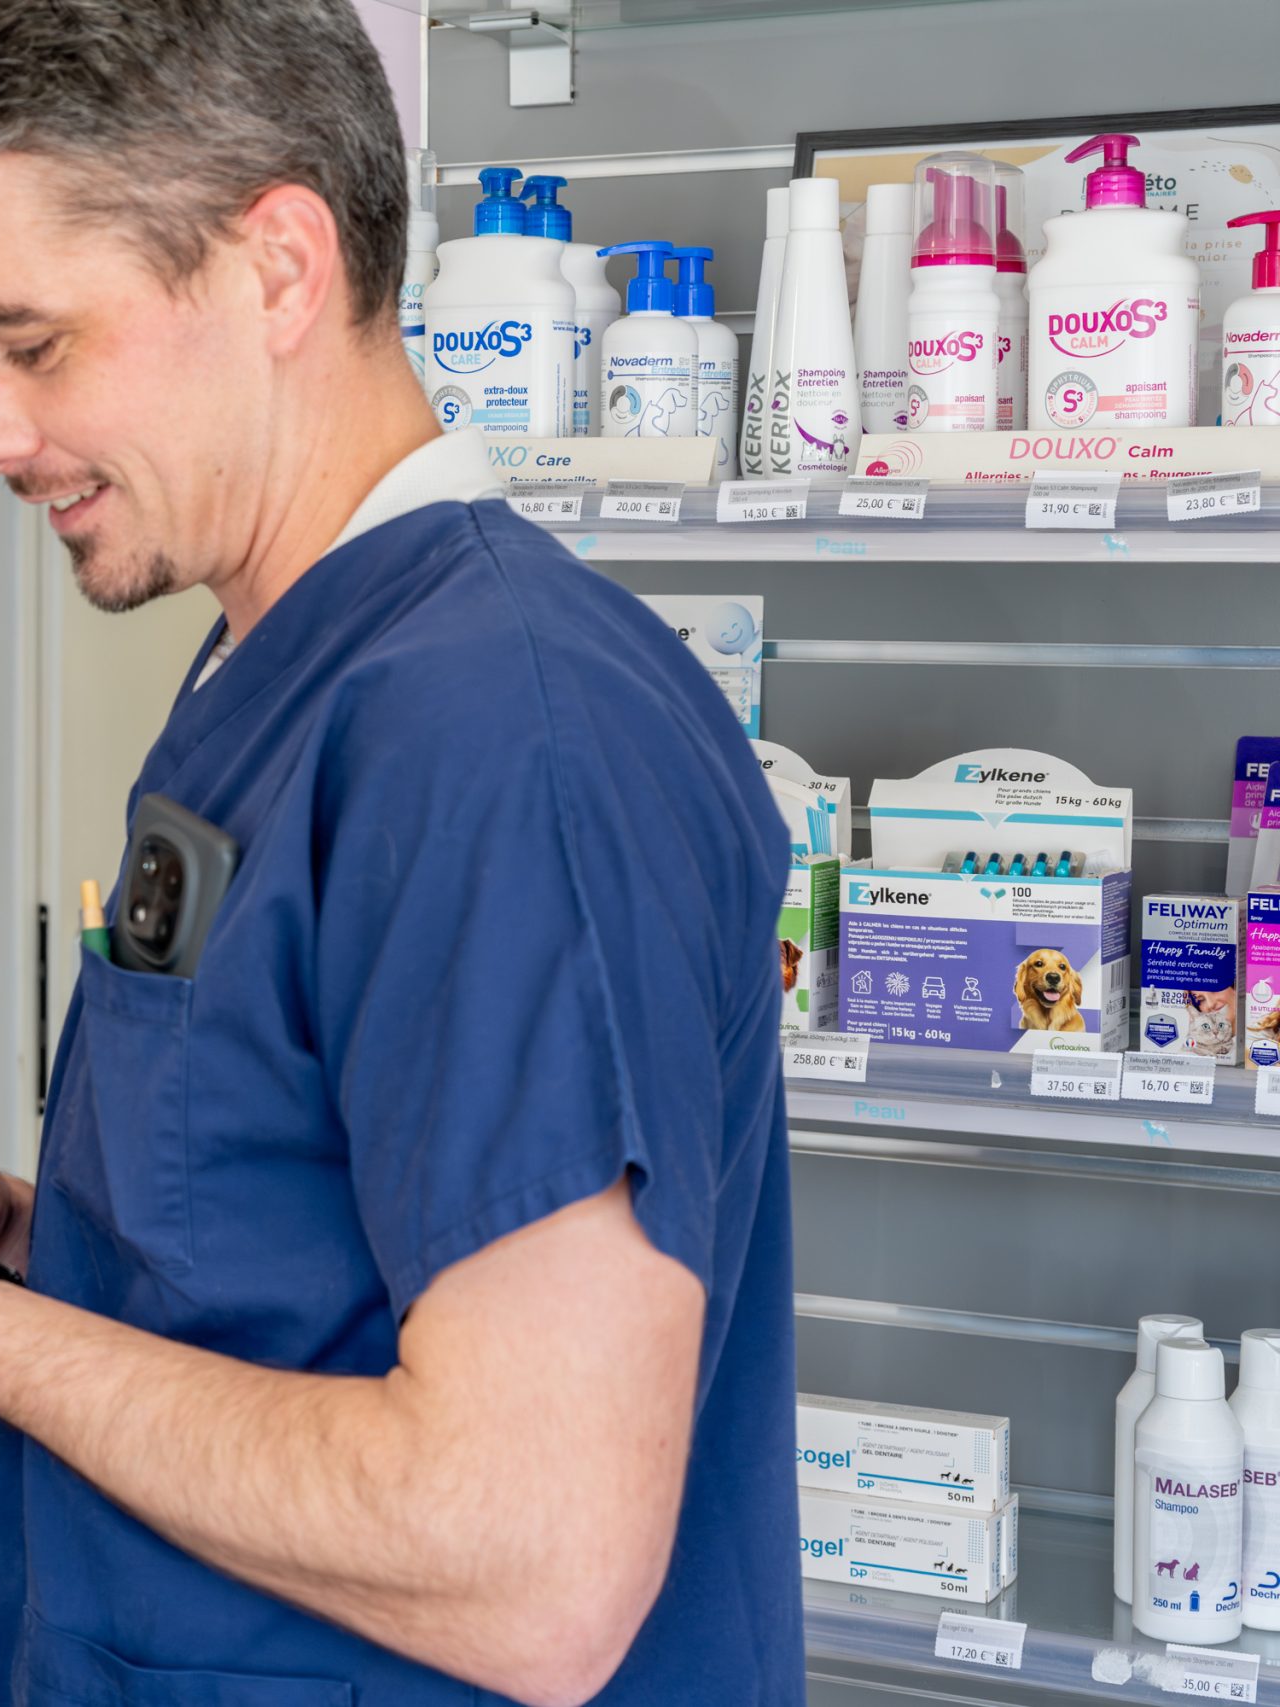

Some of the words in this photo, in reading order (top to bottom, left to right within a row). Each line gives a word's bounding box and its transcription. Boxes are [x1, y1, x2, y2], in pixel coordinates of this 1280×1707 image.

[1205, 239, 1243, 251] prise
[1070, 336, 1109, 350] CALM
[450, 353, 482, 366] CARE
[609, 356, 673, 367] Novaderm
[797, 368, 846, 379] Shampoing
[797, 378, 839, 388] Entretien
[862, 379, 903, 388] Entretien
[1125, 381, 1167, 394] apaisant
[483, 385, 529, 396] extra-doux
[486, 397, 529, 409] protecteur
[954, 394, 985, 404] apaisant
[1115, 409, 1167, 421] shampooing
[483, 422, 529, 433] shampooing
[744, 371, 766, 476] KERIOX
[770, 369, 792, 476] KERIOX
[1008, 437, 1118, 460] DOUXO
[1128, 445, 1174, 459] Calm
[535, 454, 572, 467] Care
[797, 463, 848, 473] Cosmétologie
[520, 501, 545, 514] 16,80
[616, 501, 642, 513] 20,00
[856, 498, 884, 510] 25,00
[1041, 503, 1070, 515] 31,90
[1185, 497, 1216, 511] 23,80
[742, 507, 768, 520] 14,30
[815, 537, 867, 554] Peau
[964, 766, 1046, 784] Zylkene
[808, 782, 822, 790] 30
[824, 782, 837, 792] kg
[858, 885, 929, 906] Zylkene
[1011, 886, 1032, 898] 100
[1148, 902, 1228, 920] FELIWAY
[1173, 918, 1229, 931] Optimum
[1147, 942, 1183, 958] Happy
[1185, 943, 1227, 960] Family
[1147, 958, 1177, 967] Sérénité
[1177, 960, 1214, 970] renforcée
[792, 1053, 826, 1067] 258,80
[1047, 1080, 1075, 1093] 37,50
[1141, 1079, 1170, 1092] 16,70
[853, 1101, 906, 1120] Peau
[796, 1448, 851, 1470] cogel
[874, 1450, 903, 1459] DENTAIRE
[1155, 1477, 1238, 1499] MALASEB
[1154, 1499, 1199, 1515] Shampoo
[799, 1536, 844, 1558] ogel
[867, 1539, 897, 1548] DENTAIRE
[1250, 1588, 1280, 1600] Dechr
[1153, 1597, 1169, 1609] 250
[1170, 1600, 1182, 1611] ml
[951, 1645, 978, 1661] 17,20
